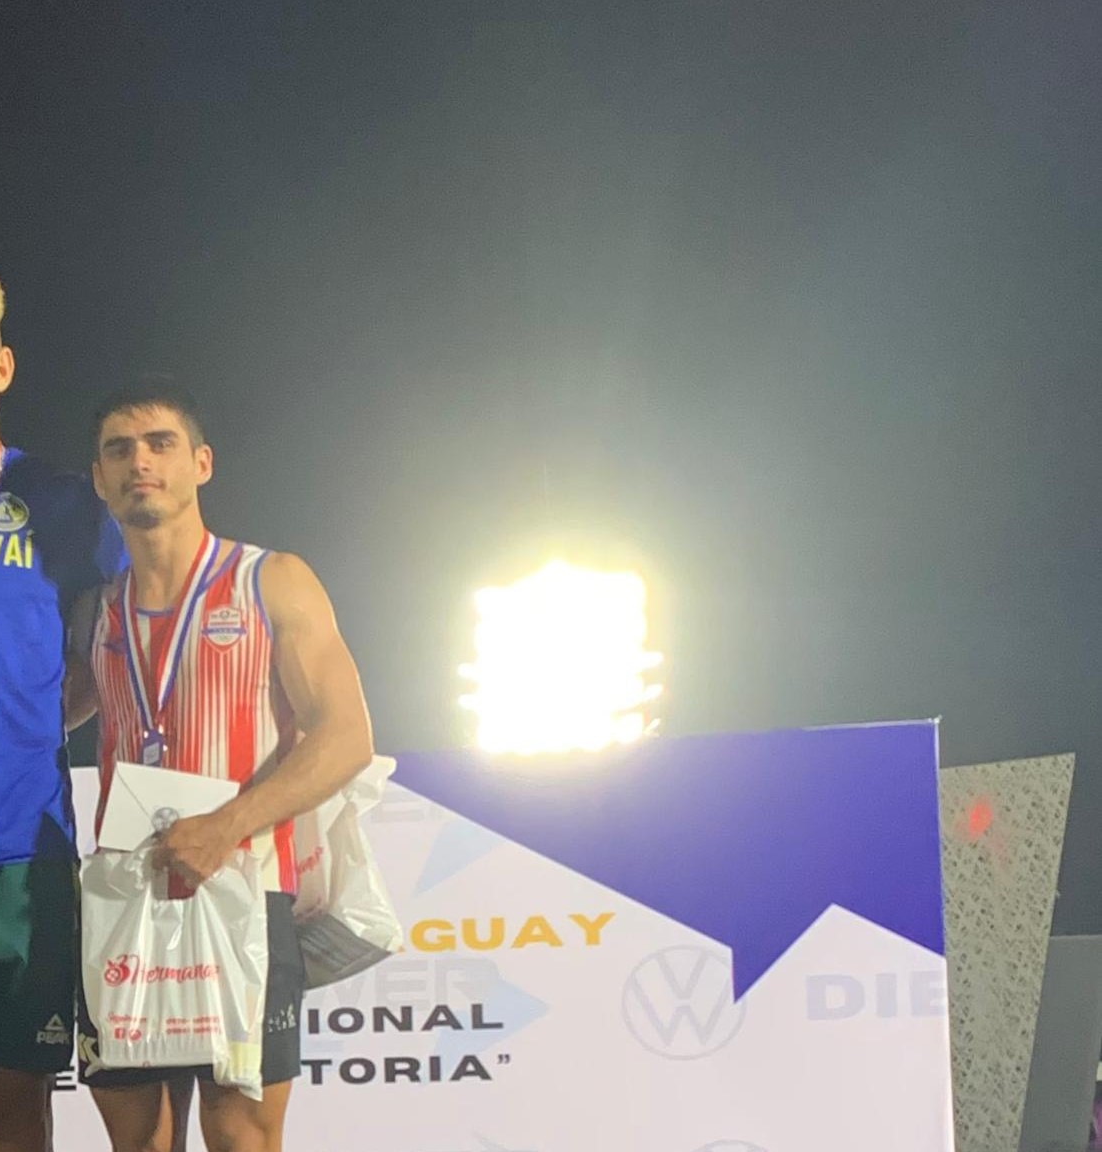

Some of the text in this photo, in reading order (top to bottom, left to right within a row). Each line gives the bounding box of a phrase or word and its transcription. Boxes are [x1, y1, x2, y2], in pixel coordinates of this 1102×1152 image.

[400, 911, 617, 955] GUAY
[805, 969, 946, 1021] DIE
[307, 1002, 505, 1036] IONAL
